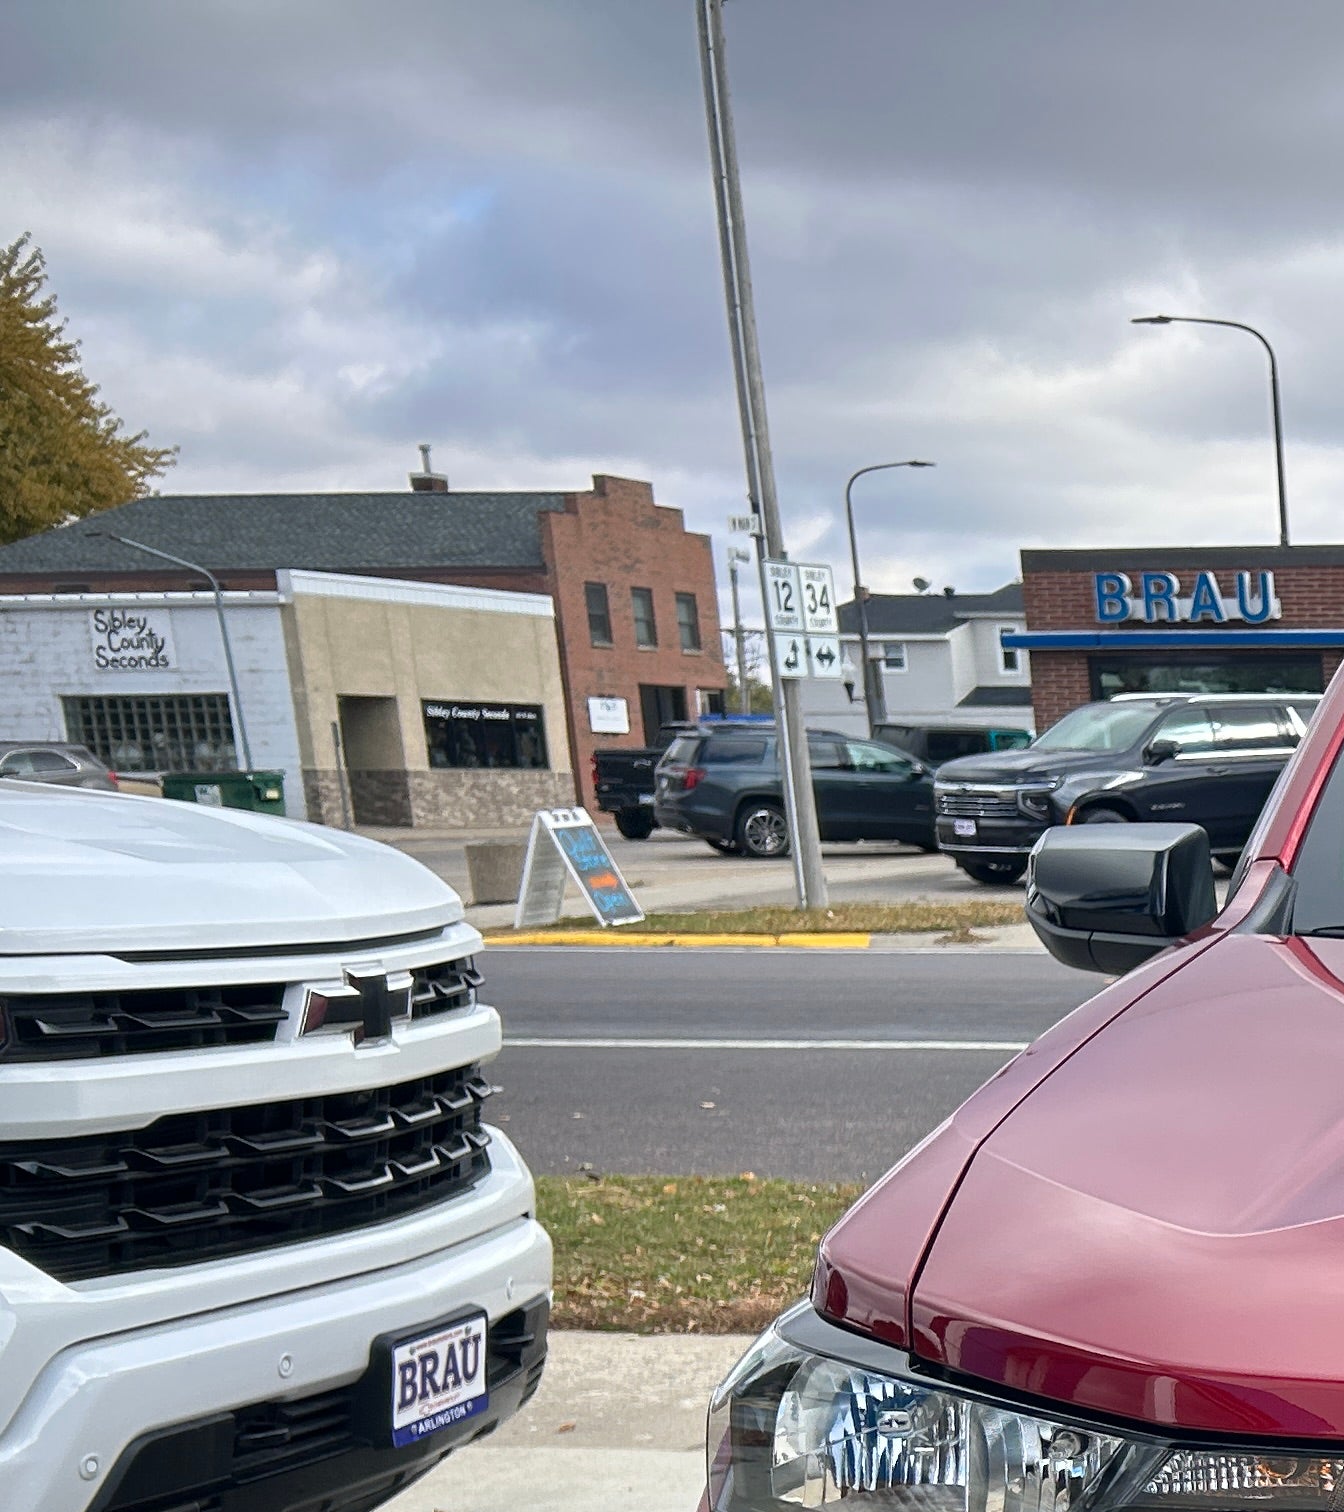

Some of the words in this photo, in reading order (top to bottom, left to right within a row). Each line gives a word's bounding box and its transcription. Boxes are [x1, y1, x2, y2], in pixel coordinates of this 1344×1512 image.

[774, 580, 795, 612] 12
[806, 583, 831, 614] 34
[1095, 571, 1275, 623] BRAU
[94, 608, 147, 635] Sibley
[108, 627, 165, 655] County
[96, 645, 169, 668] Seconds
[398, 1333, 481, 1413] BRAU
[417, 1406, 467, 1435] ARLINGTON
